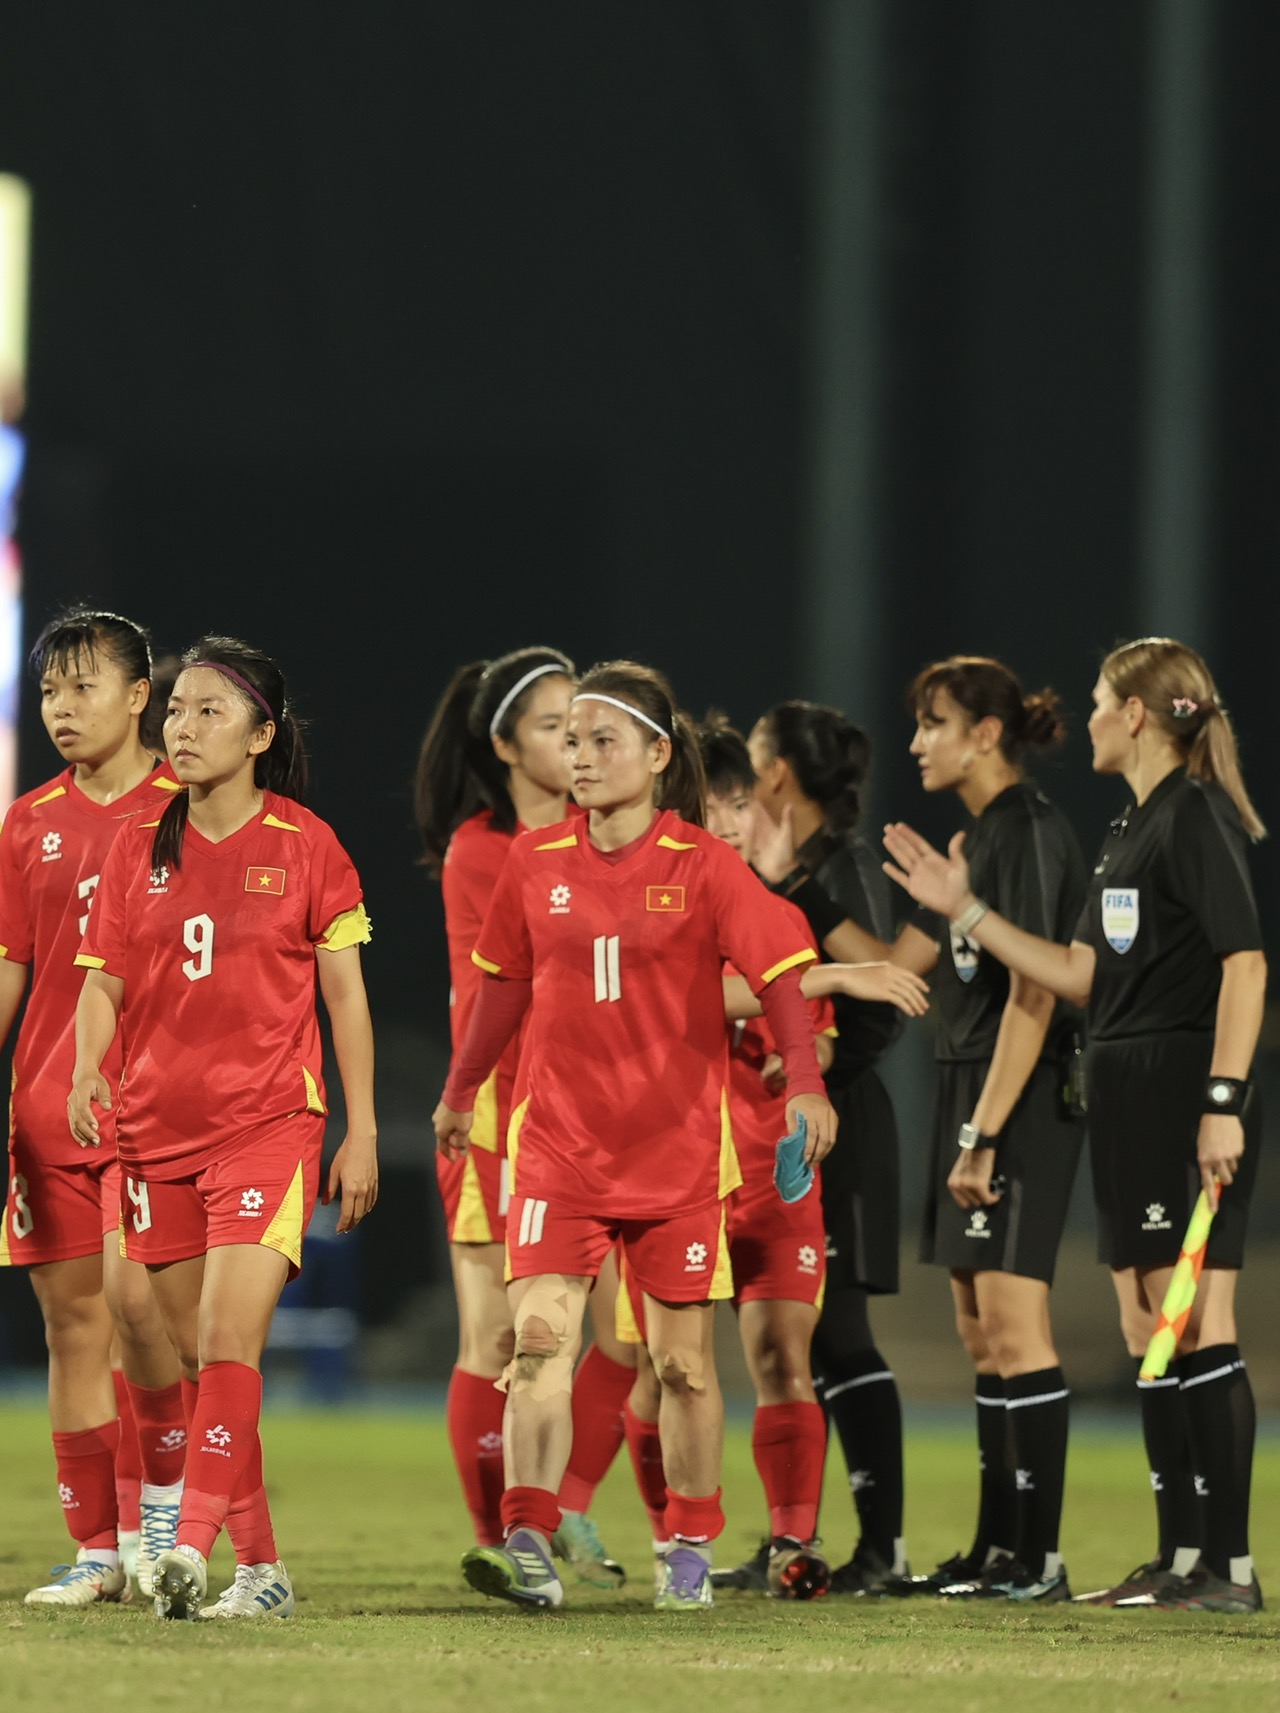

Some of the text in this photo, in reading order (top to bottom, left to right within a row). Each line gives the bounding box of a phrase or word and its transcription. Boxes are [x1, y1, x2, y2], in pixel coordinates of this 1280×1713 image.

[1105, 895, 1133, 908] FIFA
[182, 913, 215, 982] 9
[593, 935, 622, 1003] 11
[11, 1173, 34, 1240] 3
[518, 1197, 549, 1247] 11
